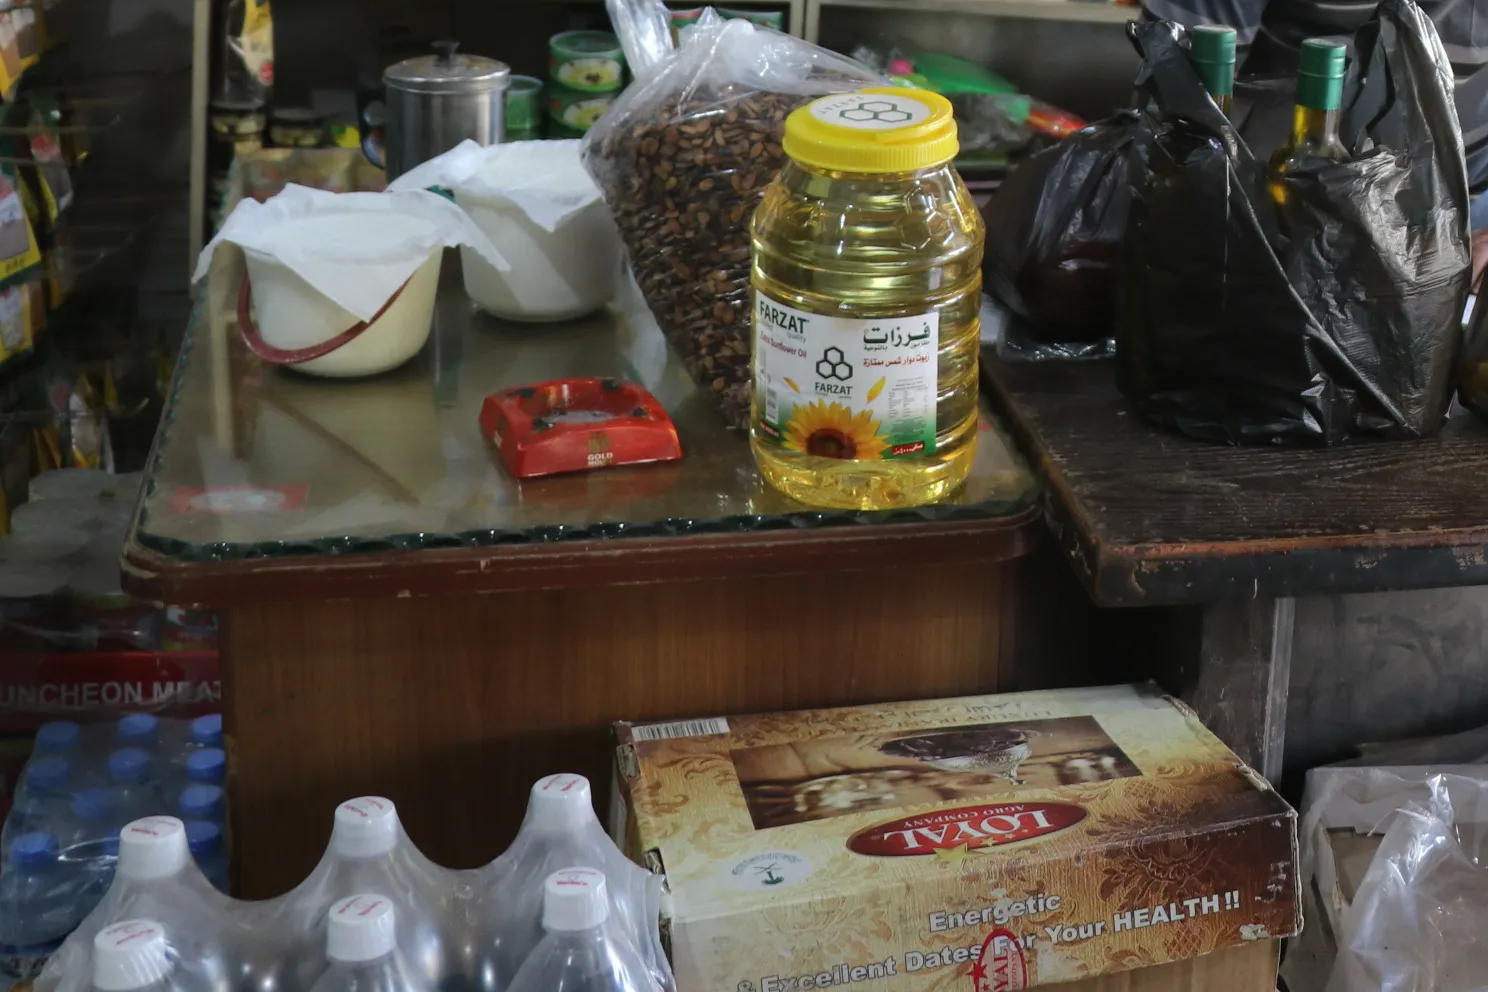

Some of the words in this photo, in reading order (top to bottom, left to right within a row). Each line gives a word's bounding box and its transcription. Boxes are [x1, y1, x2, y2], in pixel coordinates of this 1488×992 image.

[760, 300, 807, 334] FARZAT
[863, 322, 931, 347] فرزات
[798, 348, 807, 358] Oil
[815, 382, 852, 396] FARZAT
[587, 452, 613, 460] GOLD
[0, 681, 142, 707] UNCHEON
[903, 811, 979, 827] COMPANY
[983, 804, 1025, 819] AGRO
[884, 809, 1054, 850] LOYAL
[928, 893, 1062, 934] Energetic
[760, 955, 897, 992] Excellent
[905, 943, 983, 973] Dates
[993, 932, 1036, 956] For
[1044, 919, 1107, 948] Your
